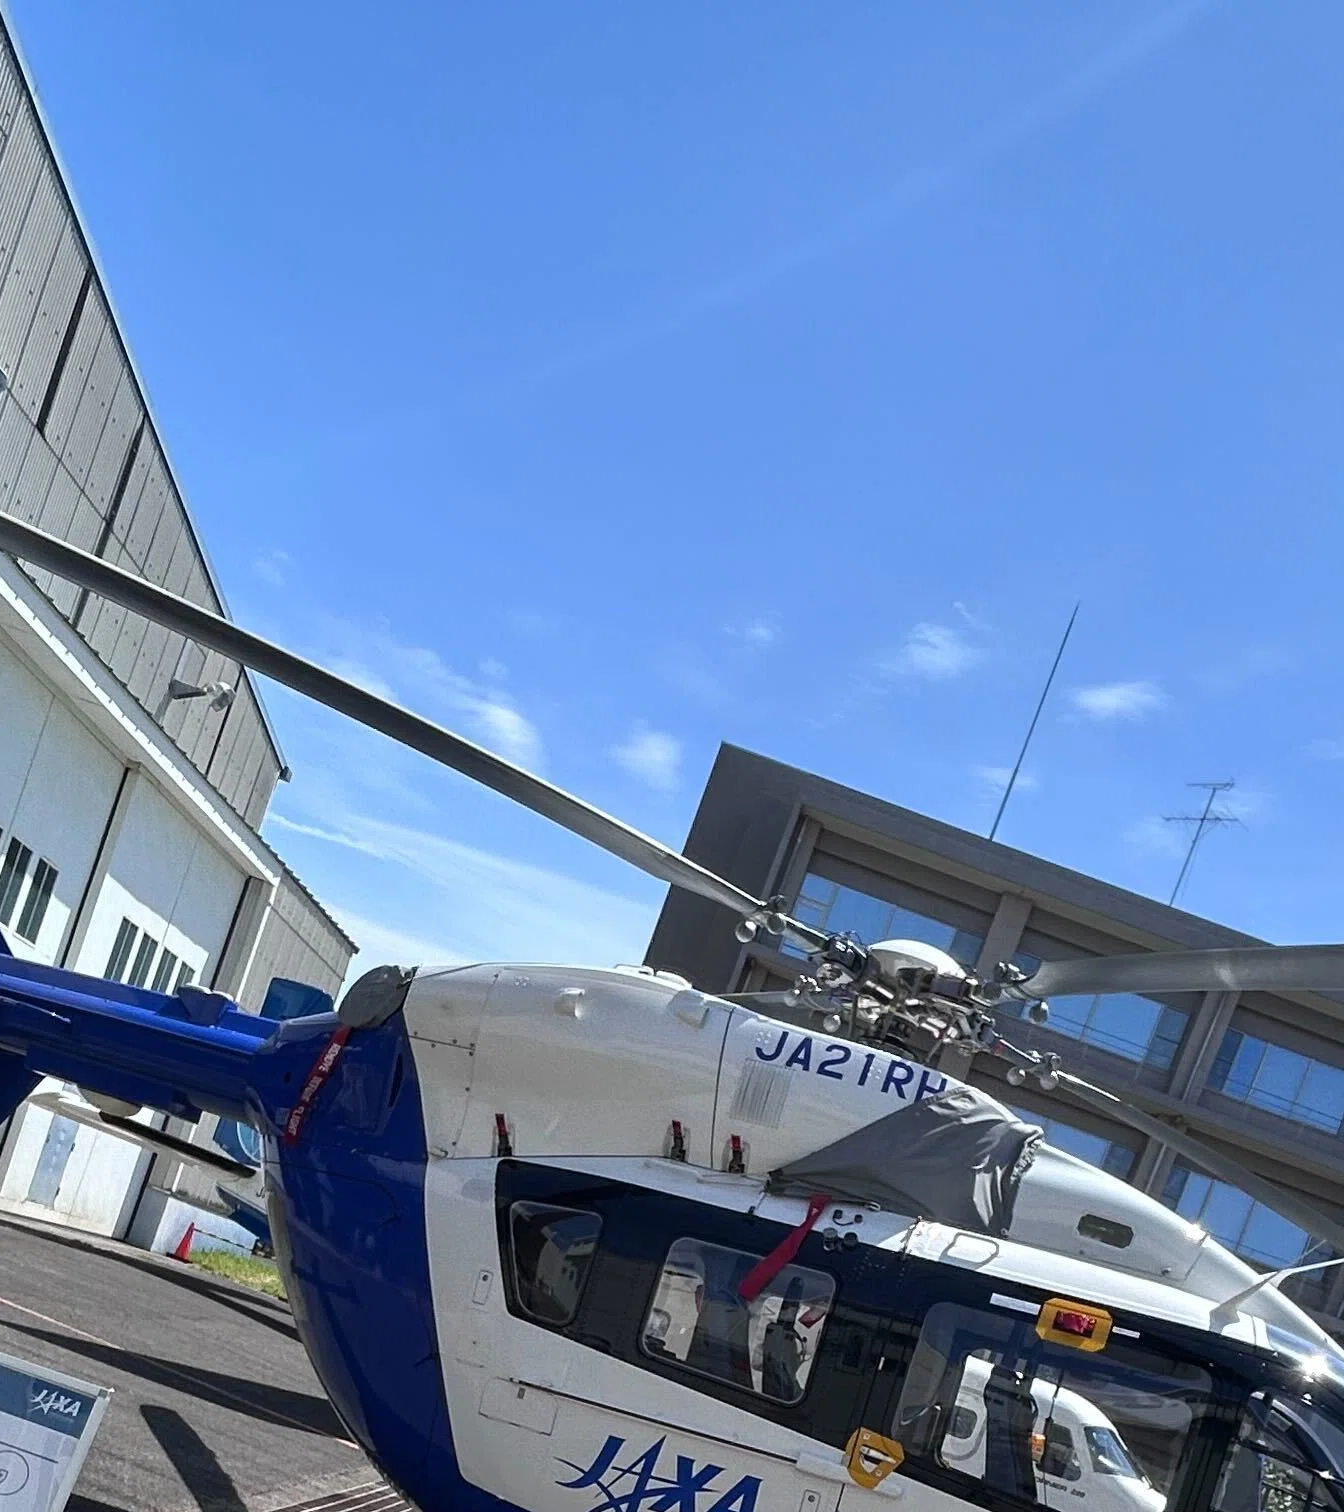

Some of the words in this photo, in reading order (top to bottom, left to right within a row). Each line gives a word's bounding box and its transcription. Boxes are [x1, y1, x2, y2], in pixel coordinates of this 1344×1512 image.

[318, 1042, 341, 1073] REMOVE
[755, 1031, 947, 1101] JA21RH
[29, 1387, 82, 1420] JAXA
